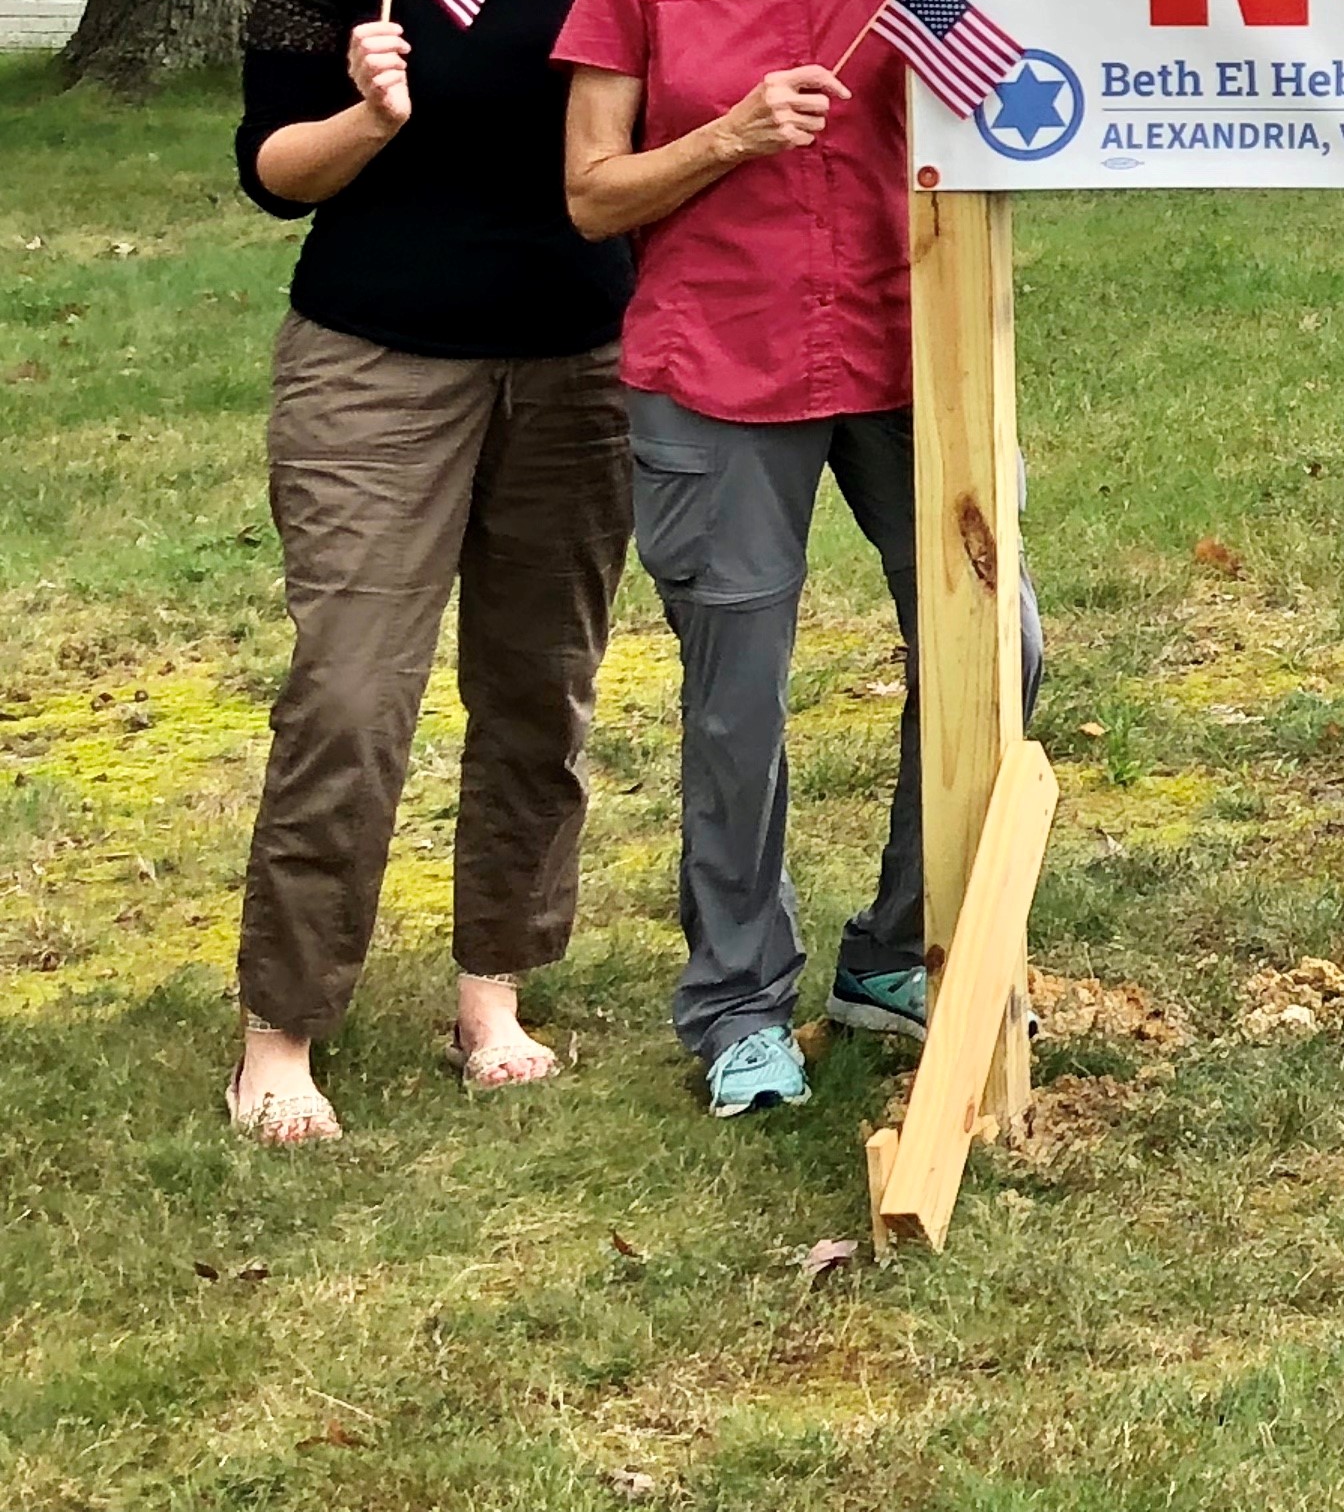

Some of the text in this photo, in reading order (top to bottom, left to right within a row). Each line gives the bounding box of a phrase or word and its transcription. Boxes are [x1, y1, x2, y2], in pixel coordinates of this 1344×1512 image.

[1101, 60, 1202, 98] Beth
[1216, 60, 1259, 97] El
[1101, 123, 1331, 156] ALEXANDRIA,
